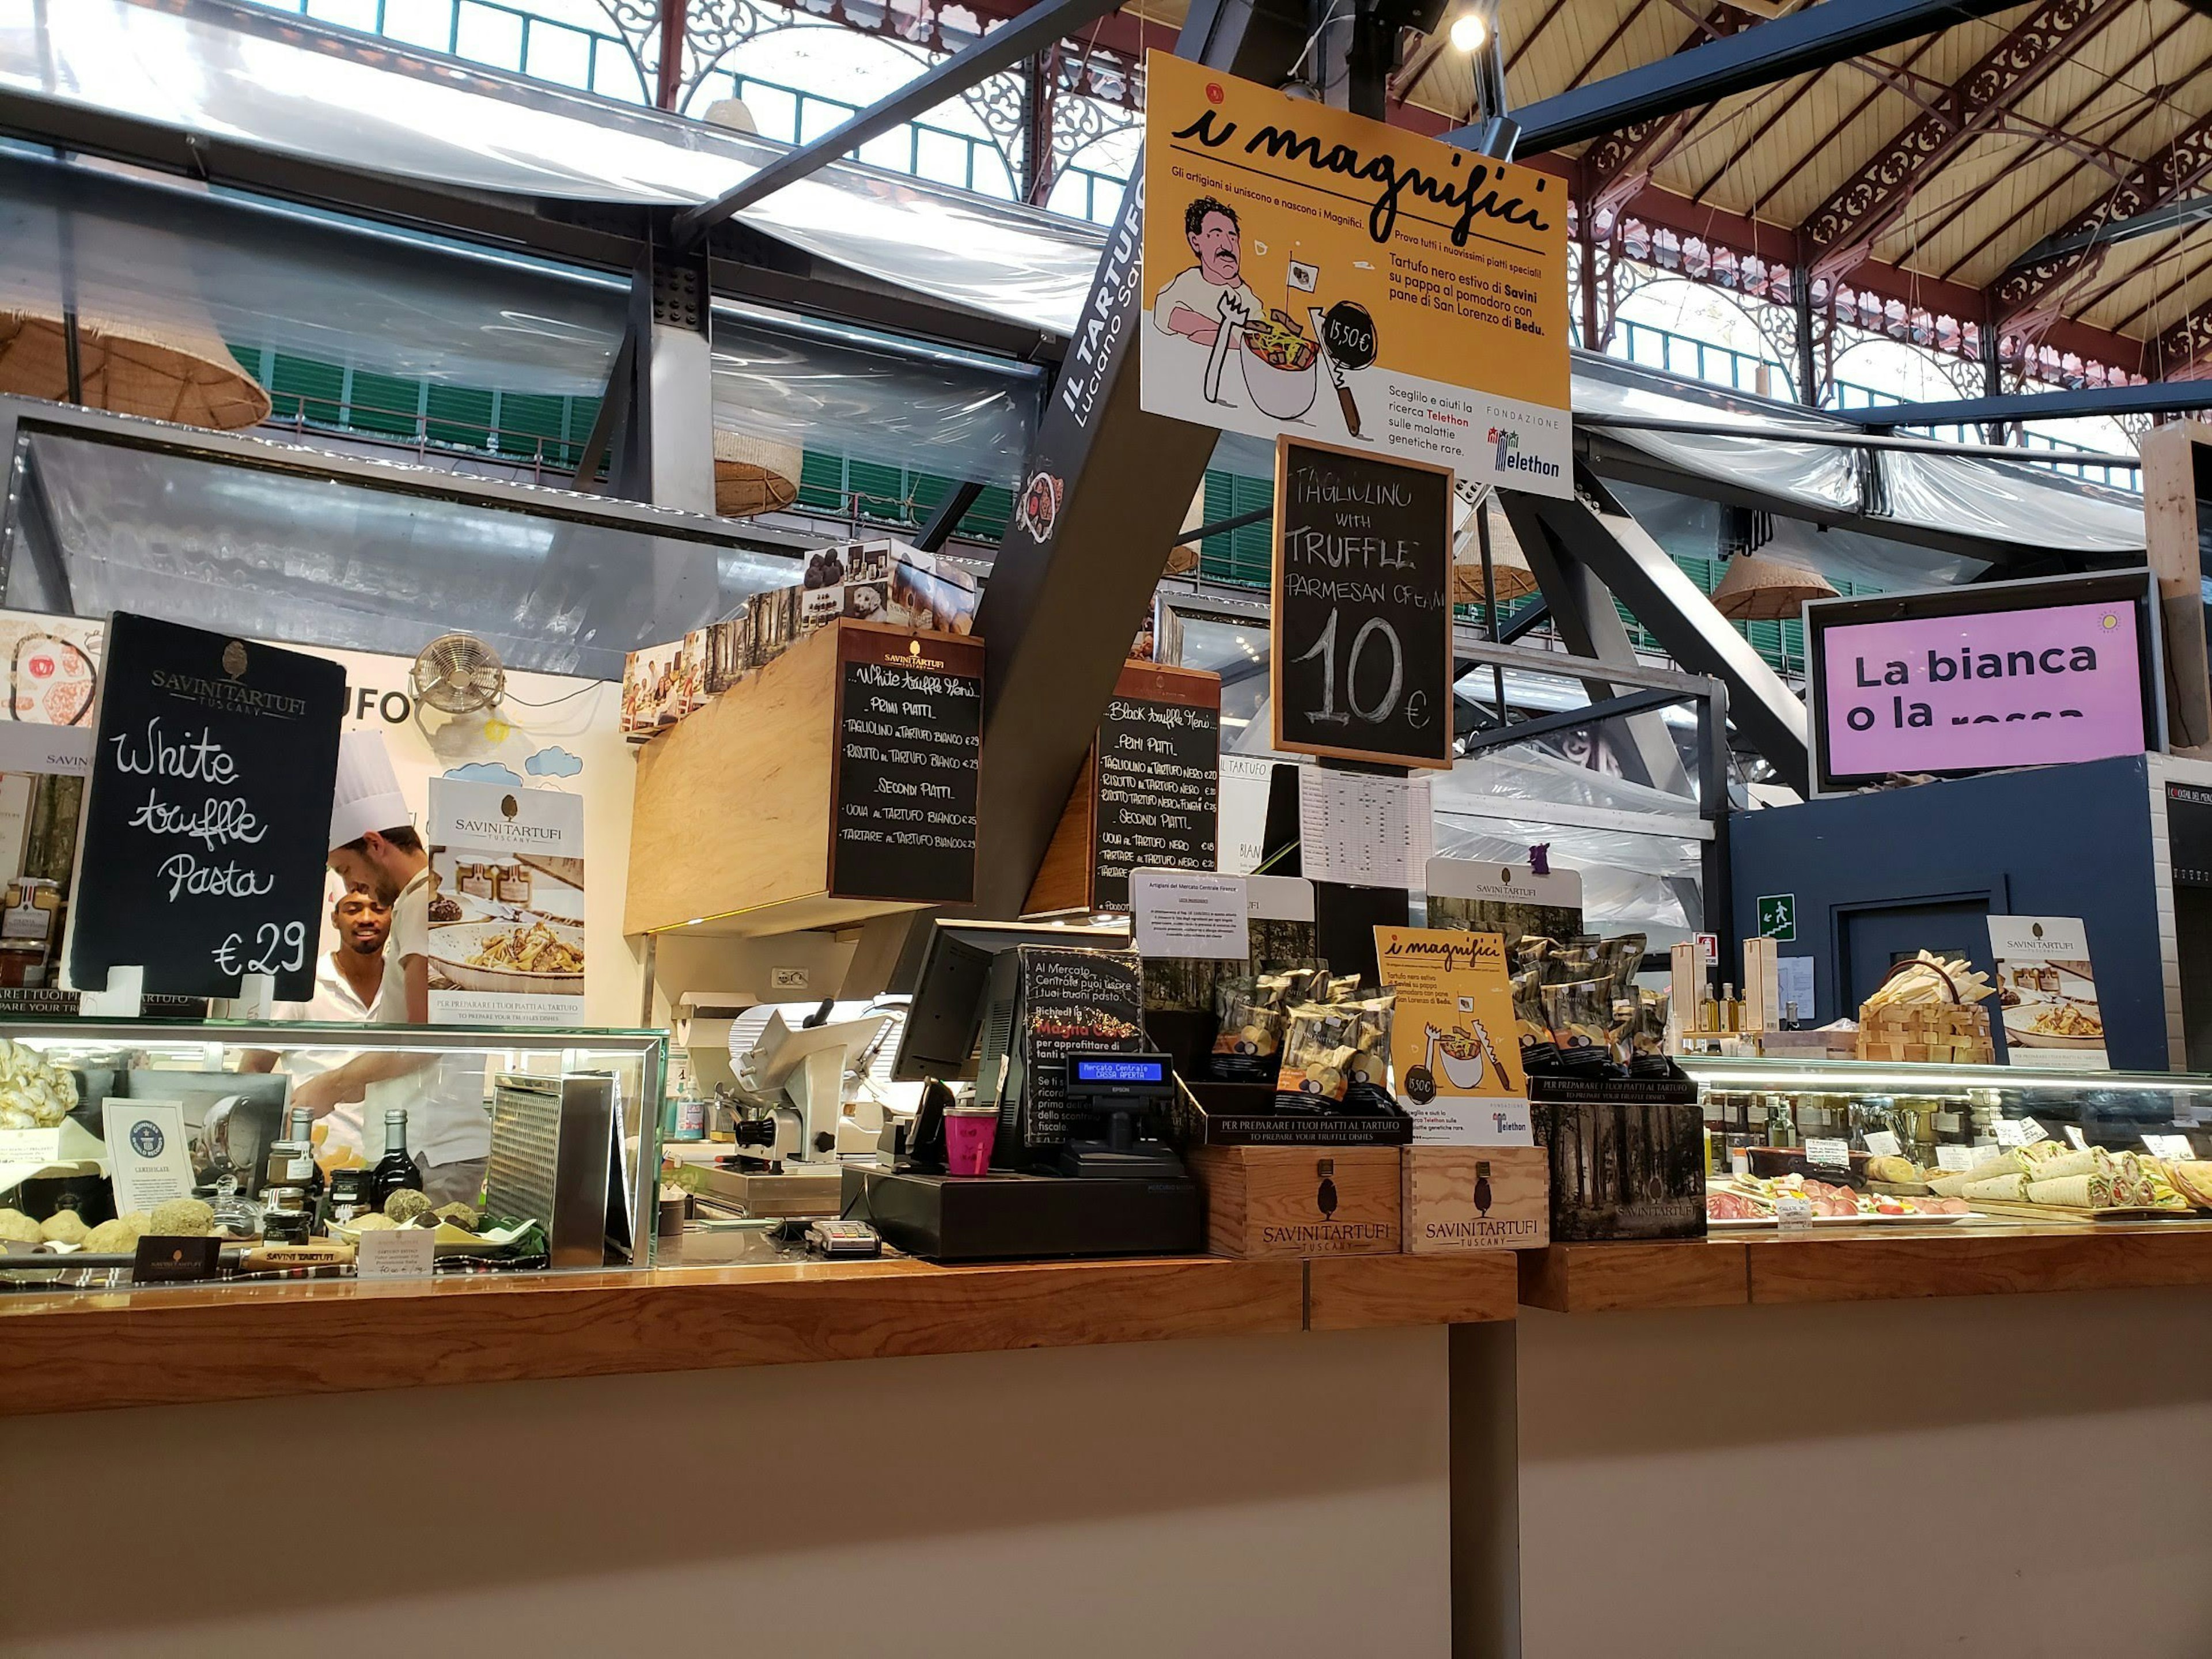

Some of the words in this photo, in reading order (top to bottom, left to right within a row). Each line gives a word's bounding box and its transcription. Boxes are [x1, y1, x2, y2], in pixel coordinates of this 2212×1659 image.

[1245, 125, 1550, 247] magnifici
[1172, 166, 1184, 179] Gli
[1186, 171, 1223, 190] artigiani
[1225, 183, 1232, 192] si
[1234, 187, 1271, 203] uniscono
[1282, 200, 1316, 216] nascono
[1319, 207, 1321, 217] i
[1324, 210, 1364, 229] Magnifici.
[1395, 230, 1418, 245] Prova
[1421, 238, 1437, 249] tutti
[1439, 241, 1441, 251] i
[1444, 244, 1484, 263] nuovissimi
[1487, 255, 1507, 269] piatti
[1509, 262, 1541, 278] speciali!
[1389, 252, 1428, 274] Tartufo
[1431, 266, 1456, 281] nero
[1459, 271, 1489, 290] estivo
[1493, 281, 1501, 294] di
[1504, 285, 1537, 304] Savini
[1389, 272, 1401, 283] su
[1405, 275, 1440, 294] pappa
[1444, 285, 1453, 297] al
[1457, 289, 1510, 312] pomodoro
[1514, 305, 1532, 317] con
[1389, 288, 1417, 304] pane
[1421, 293, 1430, 307] di
[1434, 298, 1454, 313] San
[1457, 303, 1499, 324] Lorenzo
[1502, 314, 1512, 328] di
[1515, 318, 1545, 336] Bedu.
[1073, 314, 1121, 428] Luciano
[1062, 377, 1085, 413] IL
[1389, 385, 1428, 404] Sceglilo
[1430, 396, 1437, 405] e
[1440, 398, 1460, 413] aiuti
[1463, 401, 1472, 414] la
[1389, 402, 1424, 418] ricerca
[1426, 408, 1469, 428] Telethon
[1486, 406, 1559, 430] FONDAZIONE
[1388, 418, 1411, 431] sulle
[1414, 421, 1455, 440] malattie
[1388, 433, 1438, 452] genetiche
[1441, 444, 1465, 457] rare.
[1336, 513, 1371, 529] WITH
[1285, 525, 1420, 570] TRUFFLE
[1285, 573, 1385, 603] PARMESAN
[1856, 656, 1909, 688] La
[1927, 645, 2097, 683] bianca
[902, 671, 943, 696] truffle
[199, 695, 261, 717] TUSCANY
[870, 696, 898, 715] PRIMI
[902, 702, 931, 718] PIATTI
[1847, 706, 1875, 732] o
[1893, 696, 1933, 728] la
[898, 726, 932, 741] TARTUFO
[933, 732, 963, 745] BIANCO
[109, 716, 241, 785] White
[846, 743, 879, 760] RISOTTO
[888, 749, 927, 765] TARTUFO
[929, 753, 960, 768] BIANCO
[1150, 762, 1183, 776] TARTUFO
[1183, 766, 1203, 779] NERO
[1229, 761, 1267, 776] TARTUFO
[878, 777, 917, 796] SECONDI
[920, 782, 950, 799] PIATTI
[1102, 773, 1137, 788] RISOTTO
[1143, 779, 1179, 793] TARTUFO
[1180, 782, 1200, 795] NERO
[1128, 793, 1157, 806] TARTUFO
[128, 787, 268, 853] truffle
[846, 803, 868, 817] UOVA
[882, 807, 923, 821] TARTUFO
[927, 812, 961, 825] BIANCO
[1119, 808, 1157, 827] SECONDI
[1160, 813, 1187, 829] PIATTI
[487, 834, 531, 843] TUSCANY
[842, 828, 884, 842] TARTARE
[892, 831, 933, 846] TARTUFO
[934, 836, 963, 849] BIANCO
[1131, 834, 1166, 849] TARTUFO
[1169, 839, 1190, 851] NERO
[1143, 853, 1176, 866] TARTUFO
[1177, 857, 1199, 868] NERO
[157, 853, 275, 903] Pasta
[1406, 937, 1501, 972] magnifici
[1048, 963, 1090, 975] Mercato
[1036, 975, 1078, 986] Centrale
[1081, 980, 1103, 990] puoi
[1041, 988, 1059, 997] tuoi
[1062, 988, 1090, 999] buoni
[31, 990, 64, 1001] TUOI
[29, 1003, 60, 1012] YOUR
[1036, 1040, 1052, 1050] per
[1054, 1040, 1109, 1050] approfittare
[1111, 1041, 1120, 1050] di
[1037, 1050, 1058, 1059] tanti
[1037, 1110, 1059, 1120] dello
[1038, 1099, 1064, 1110] prima
[1222, 1120, 1238, 1130] PER
[1240, 1120, 1290, 1130] PREPARARE
[1297, 1121, 1319, 1130] TUOI
[1322, 1122, 1347, 1130] PIATTI
[1361, 1122, 1399, 1131] TARTUFO
[1262, 1133, 1294, 1141] PREPARE
[1296, 1133, 1316, 1141] YOUR
[1349, 1133, 1373, 1141] DISHES
[1302, 1243, 1354, 1252] TUSCANY
[1461, 1237, 1506, 1247] TUSCANY
